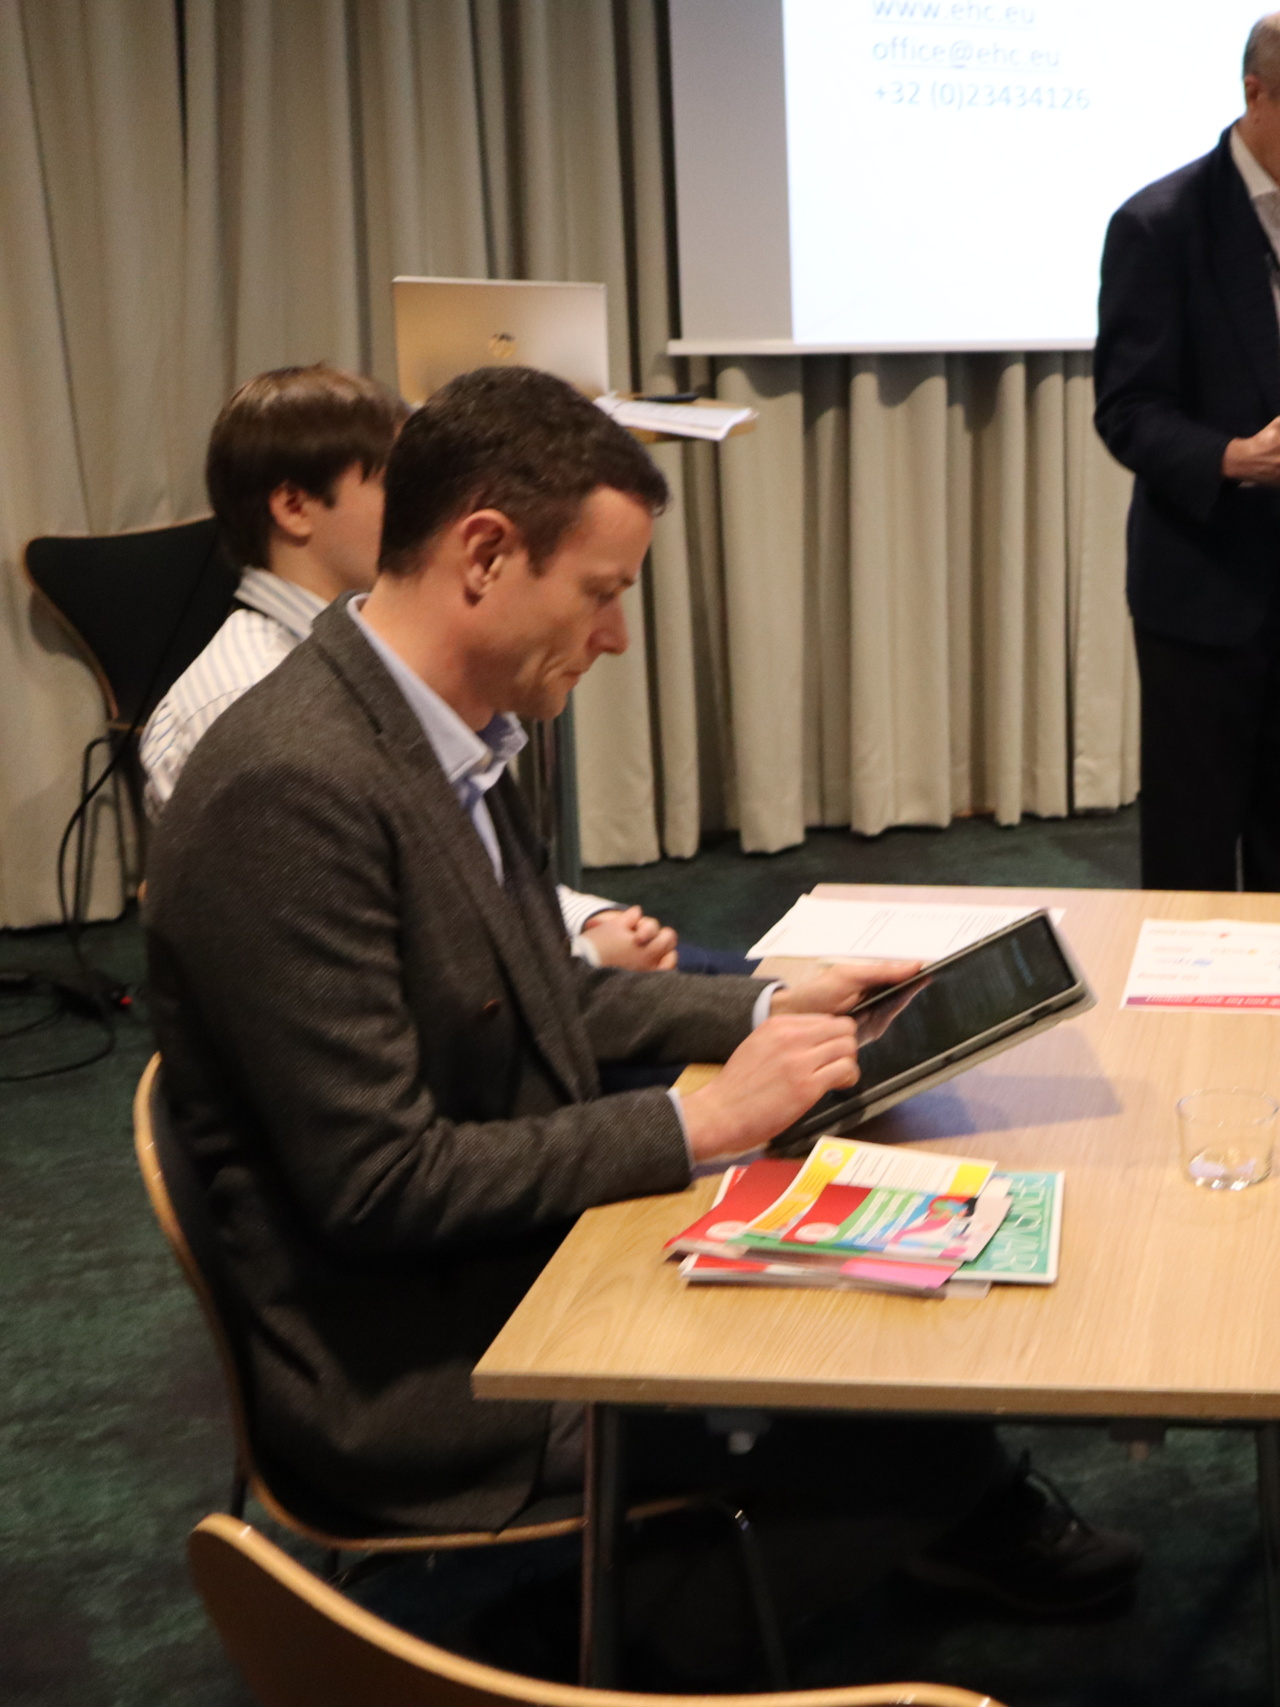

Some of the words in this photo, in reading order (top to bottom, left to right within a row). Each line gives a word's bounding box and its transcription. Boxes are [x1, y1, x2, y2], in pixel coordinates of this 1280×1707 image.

[872, 0, 1035, 25] www.ehc.eu
[872, 35, 1060, 68] office@ehc.eu
[874, 80, 921, 105] +32
[930, 80, 1091, 111] (0)23434126
